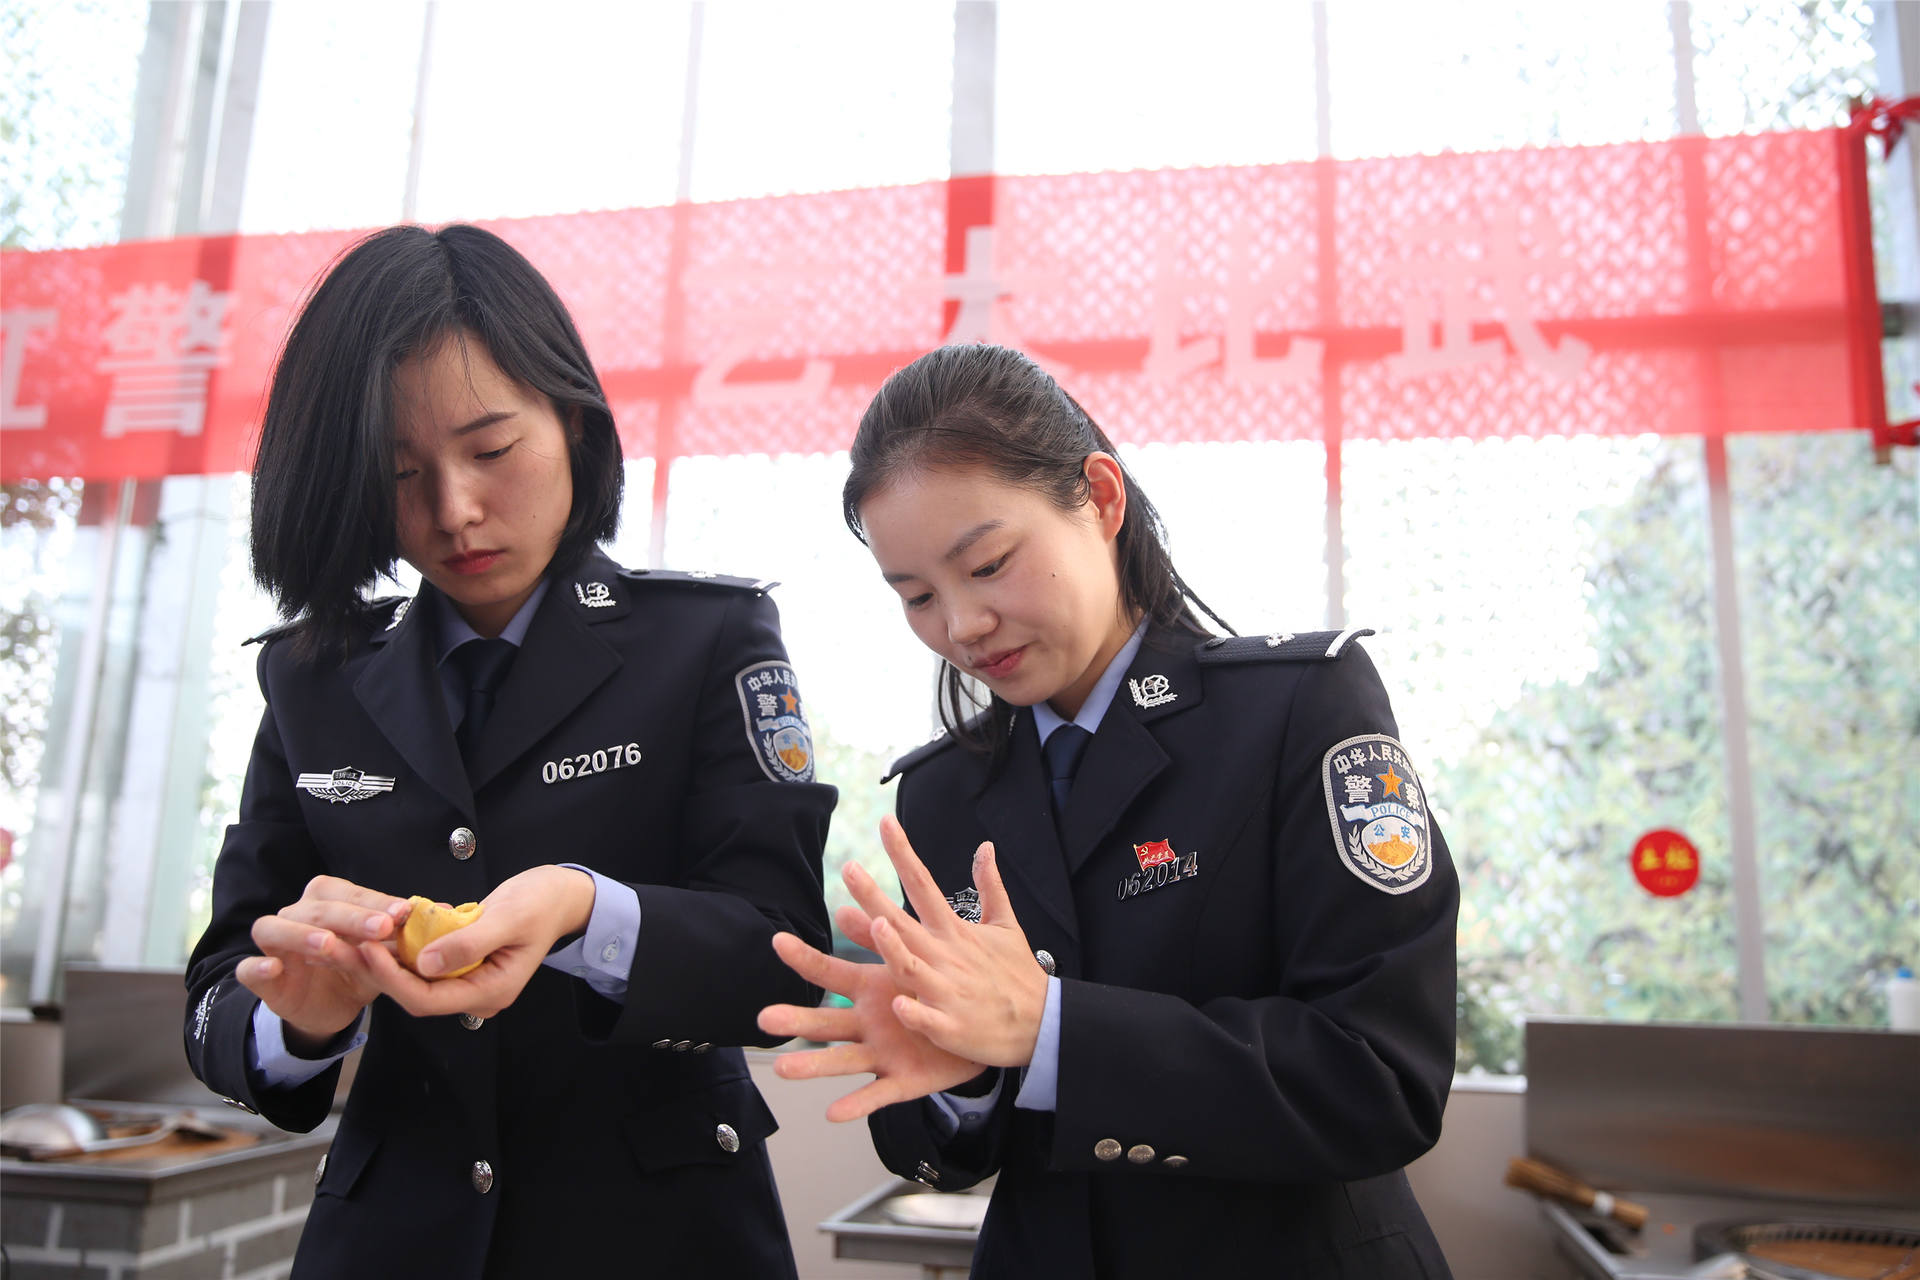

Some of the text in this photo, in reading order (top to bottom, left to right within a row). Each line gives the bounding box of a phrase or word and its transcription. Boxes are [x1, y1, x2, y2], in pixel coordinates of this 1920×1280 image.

[542, 742, 642, 784] 062076
[1344, 774, 1373, 804] 警
[1371, 804, 1412, 820] POLICE
[1117, 851, 1198, 901] 062014
